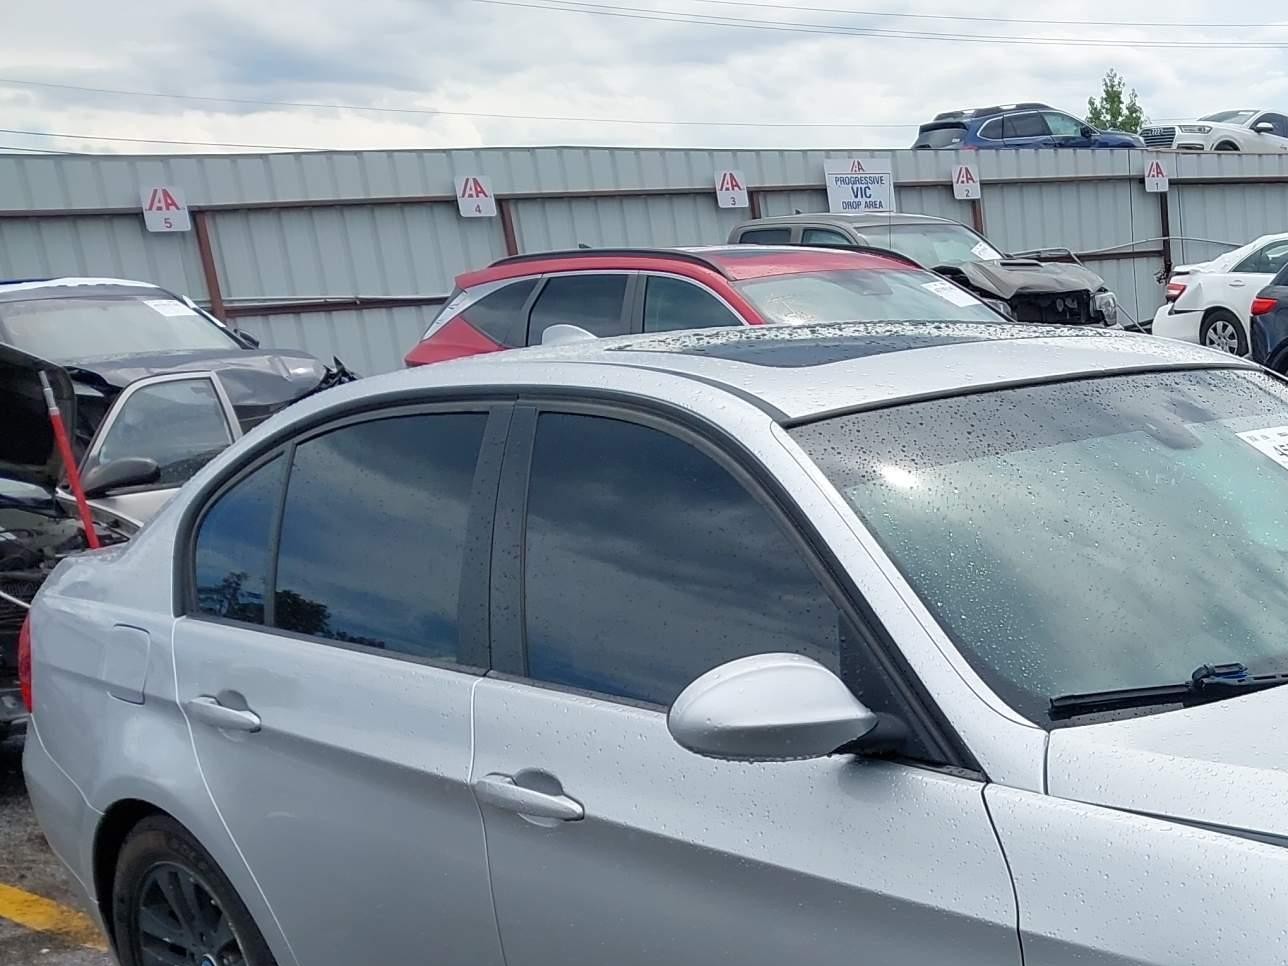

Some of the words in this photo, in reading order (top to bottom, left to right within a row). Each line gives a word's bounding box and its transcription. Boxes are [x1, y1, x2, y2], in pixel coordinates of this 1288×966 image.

[834, 175, 885, 186] PROGRESSIVE
[851, 186, 872, 199] VIC
[730, 196, 737, 206] 3
[842, 201, 862, 210] DROP
[864, 200, 884, 209] AREA
[475, 204, 482, 214] 4
[164, 218, 173, 229] 5
